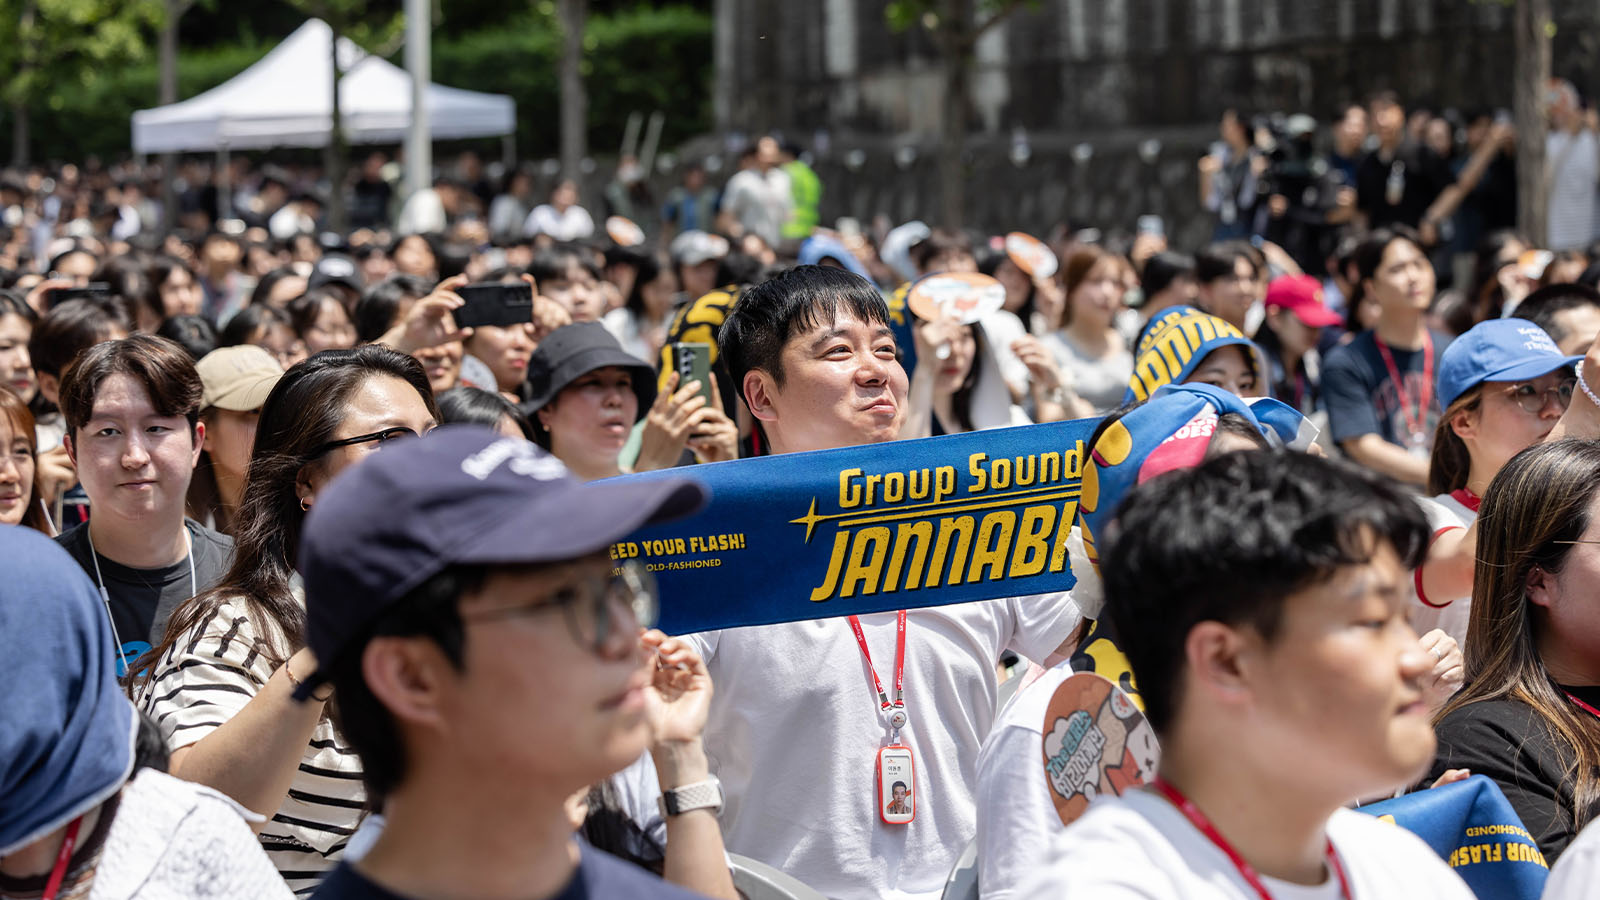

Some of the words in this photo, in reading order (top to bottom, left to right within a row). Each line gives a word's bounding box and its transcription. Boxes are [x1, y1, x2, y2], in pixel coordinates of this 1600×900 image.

[839, 464, 955, 509] Group
[968, 440, 1085, 492] Sound
[609, 542, 639, 560] EED
[642, 538, 687, 556] YOUR
[689, 533, 746, 553] FLASH!
[646, 558, 722, 572] OLD-FASHIONED
[1506, 842, 1549, 869] YOUR
